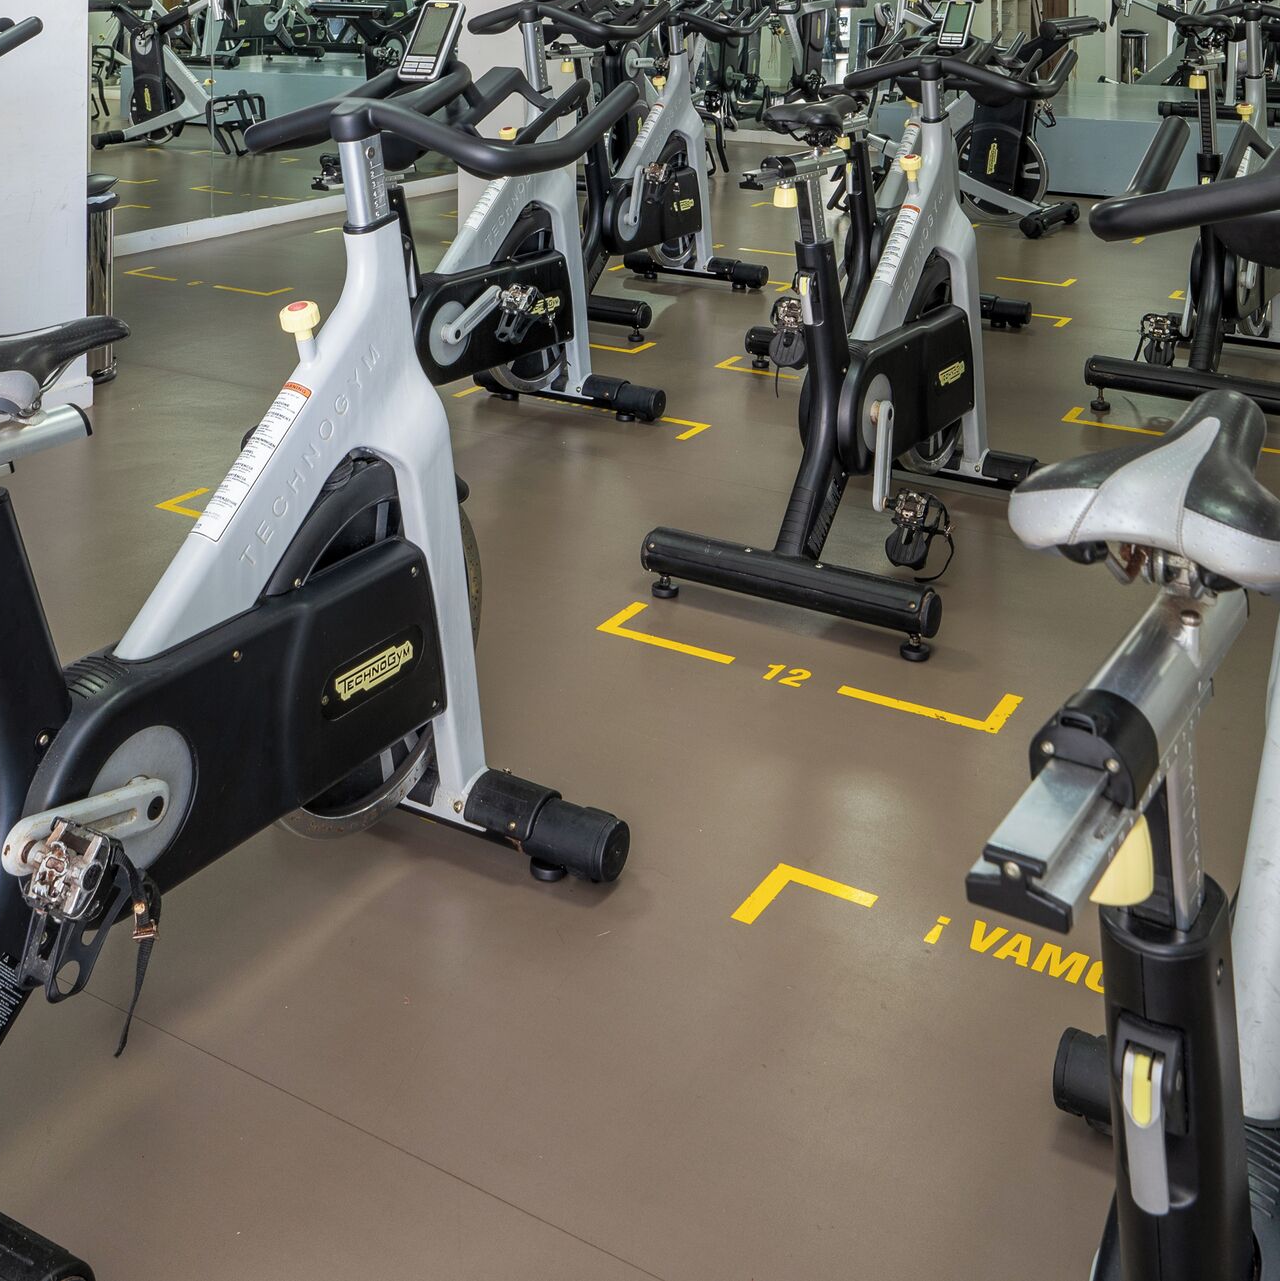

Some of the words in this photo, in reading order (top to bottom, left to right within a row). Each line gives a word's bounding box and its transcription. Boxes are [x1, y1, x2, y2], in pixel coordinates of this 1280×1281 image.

[238, 343, 381, 567] TECHNOGYM
[337, 644, 411, 695] TECHNOGYM
[762, 664, 812, 688] 12
